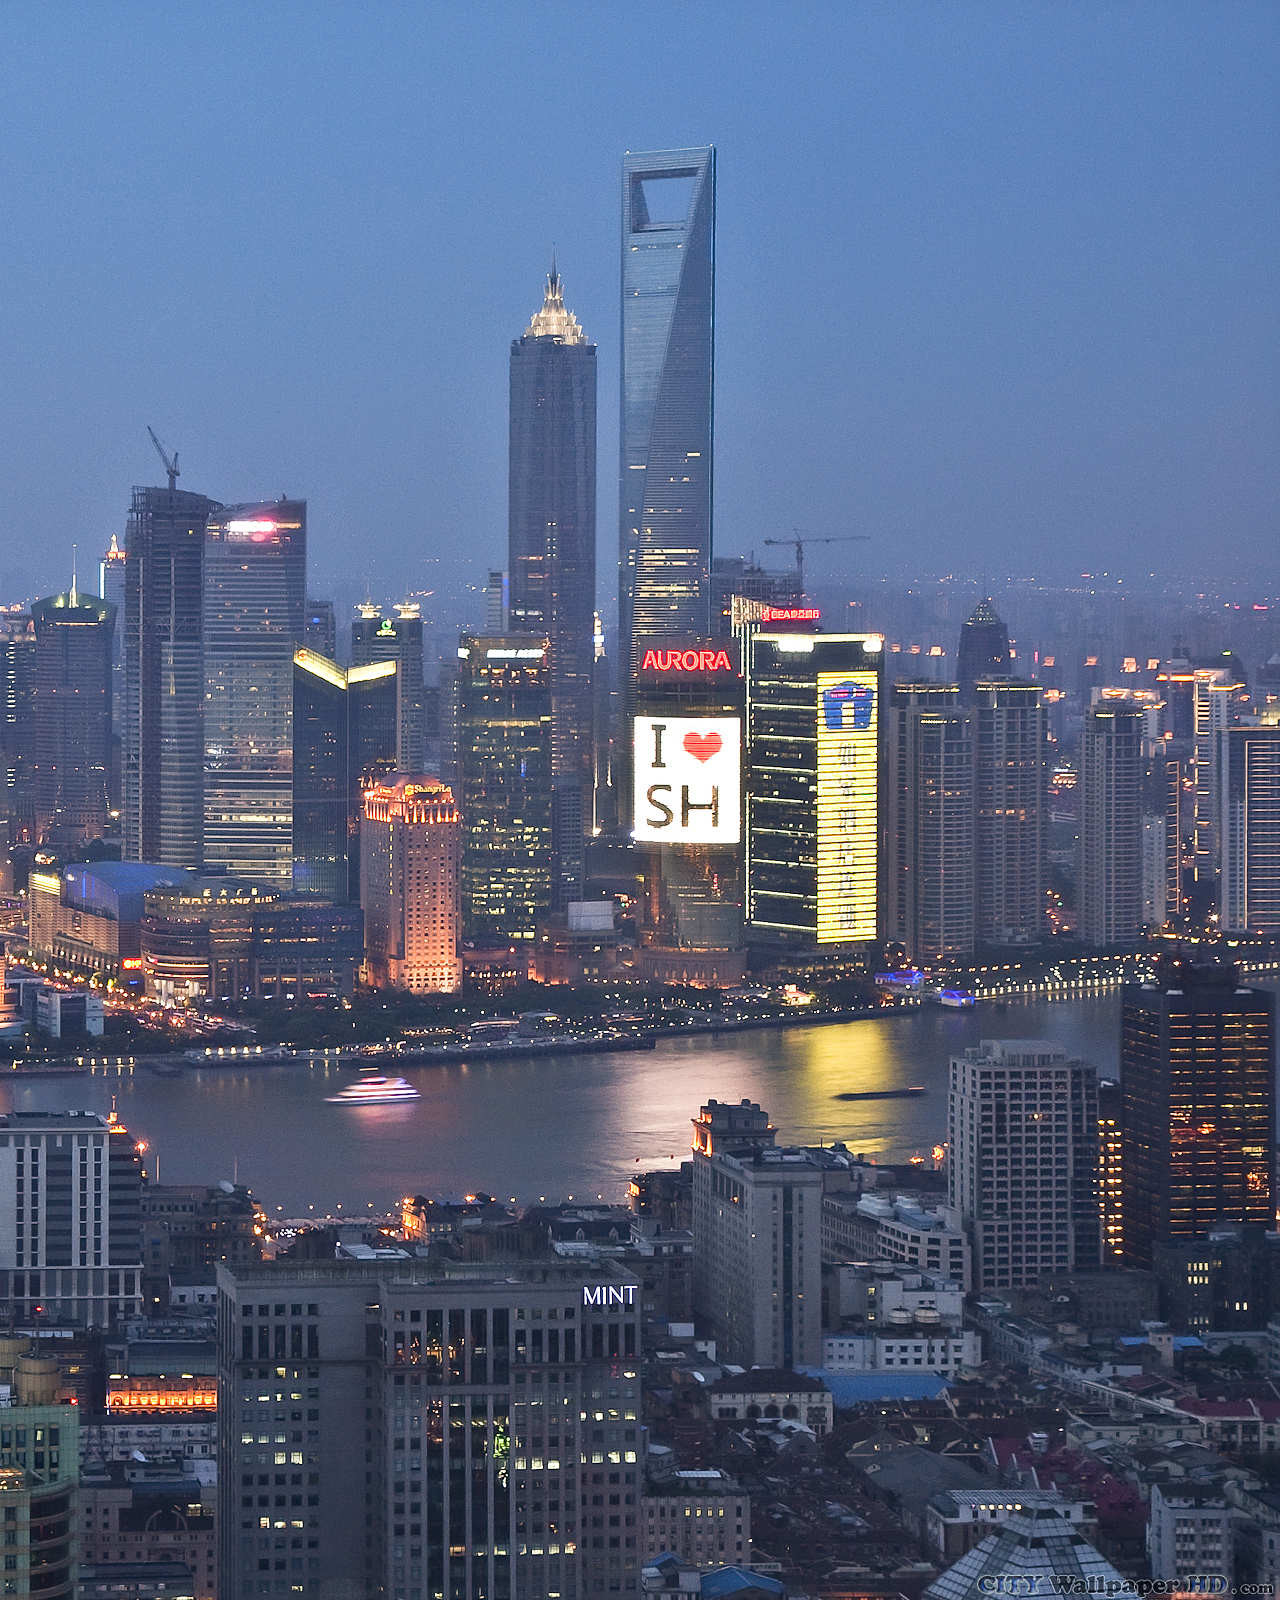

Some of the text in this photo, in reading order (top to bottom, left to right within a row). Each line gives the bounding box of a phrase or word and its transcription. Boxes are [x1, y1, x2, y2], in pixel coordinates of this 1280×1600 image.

[642, 650, 731, 671] AURORA
[651, 724, 667, 768] I
[646, 784, 719, 829] SH
[583, 1285, 639, 1306] MINT
